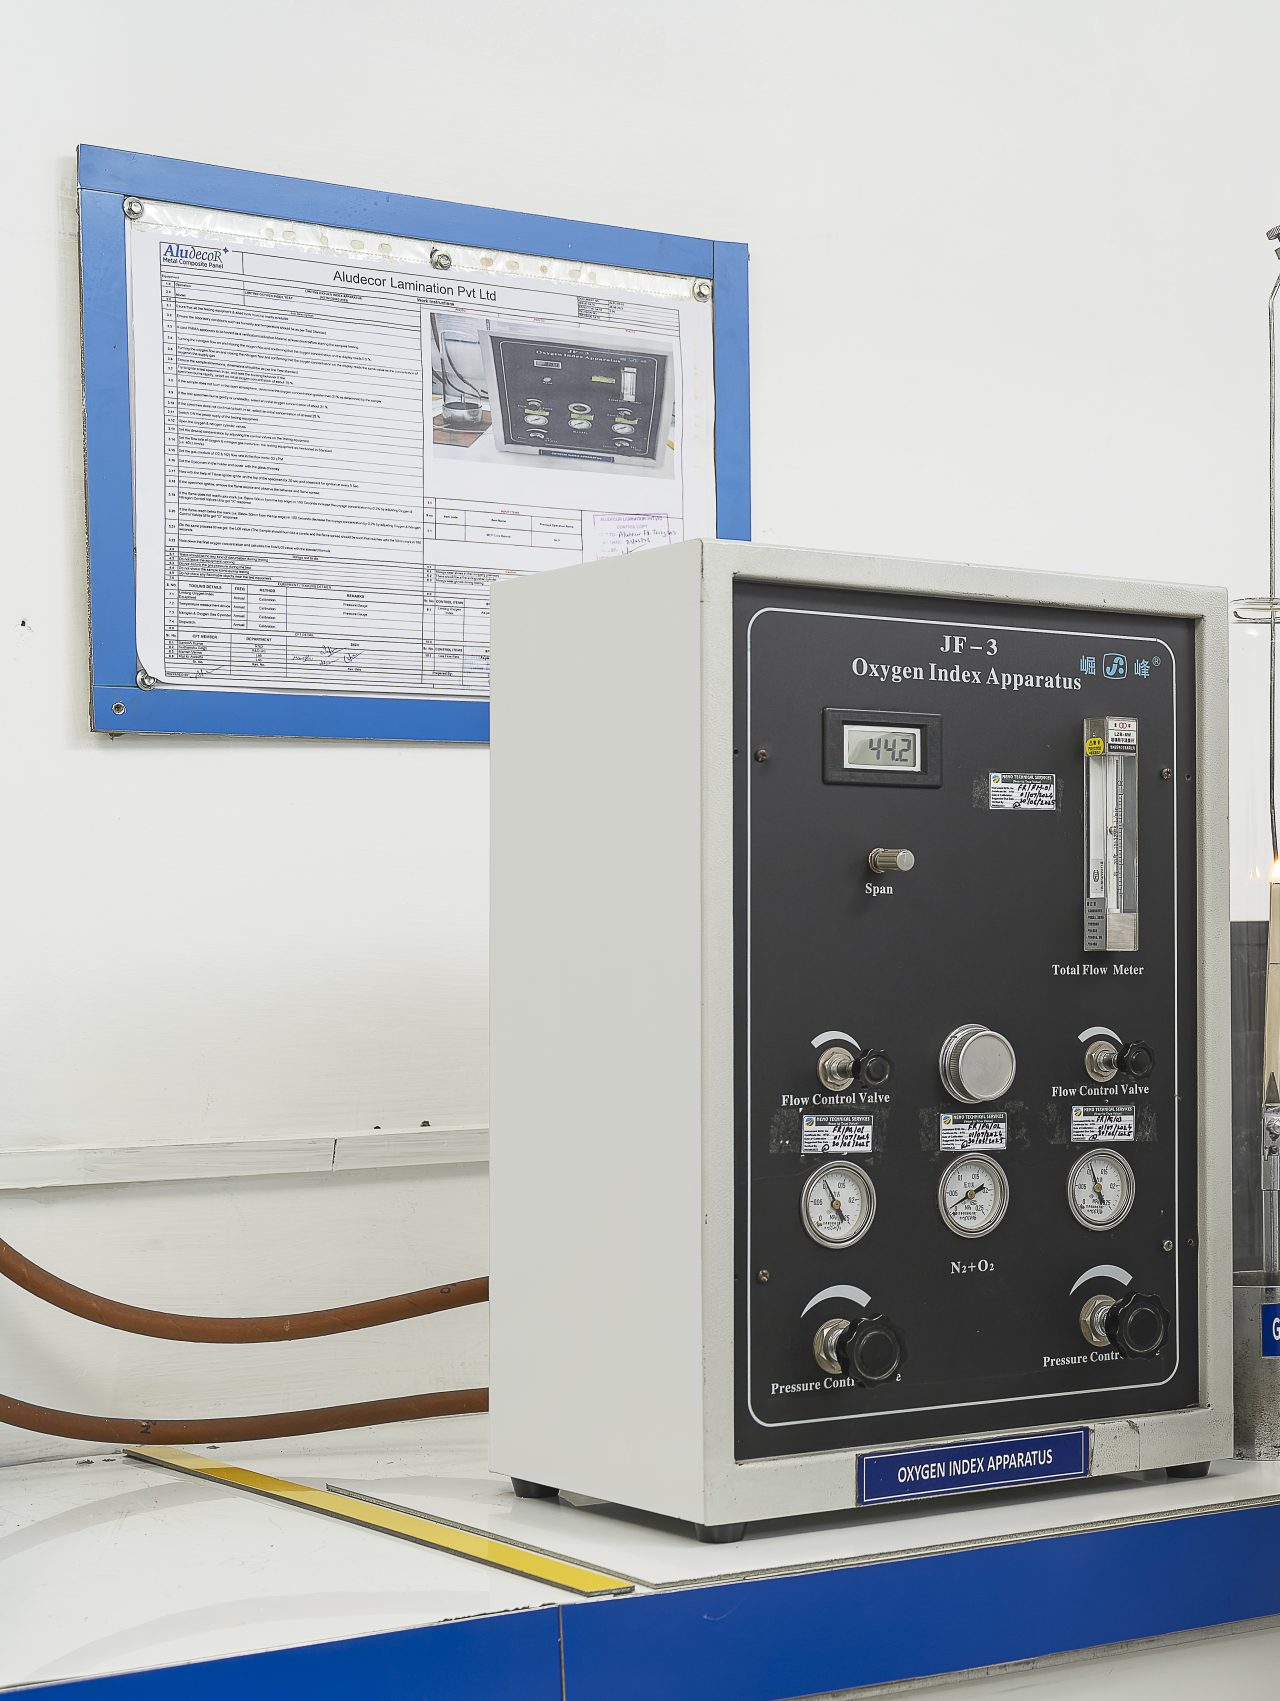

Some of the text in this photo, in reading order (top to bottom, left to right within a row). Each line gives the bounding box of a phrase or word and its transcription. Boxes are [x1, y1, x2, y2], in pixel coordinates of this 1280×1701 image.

[179, 259, 207, 268] Composite
[333, 271, 496, 301] Aludecor Lamination Pvt Ltd
[852, 657, 1082, 692] Oxygen Index Apparatus
[868, 738, 910, 763] 44.2
[865, 883, 894, 895] Span
[1052, 964, 1145, 976] Total Flow Meter
[781, 1091, 890, 1106] Flow Control Valve
[1052, 1083, 1150, 1097] Flow Control Valve
[1043, 1350, 1126, 1368] Pressure Contr
[770, 1375, 856, 1395] Pressure Contr
[897, 1448, 1054, 1484] OXYGEN INDEX APPARATUS
